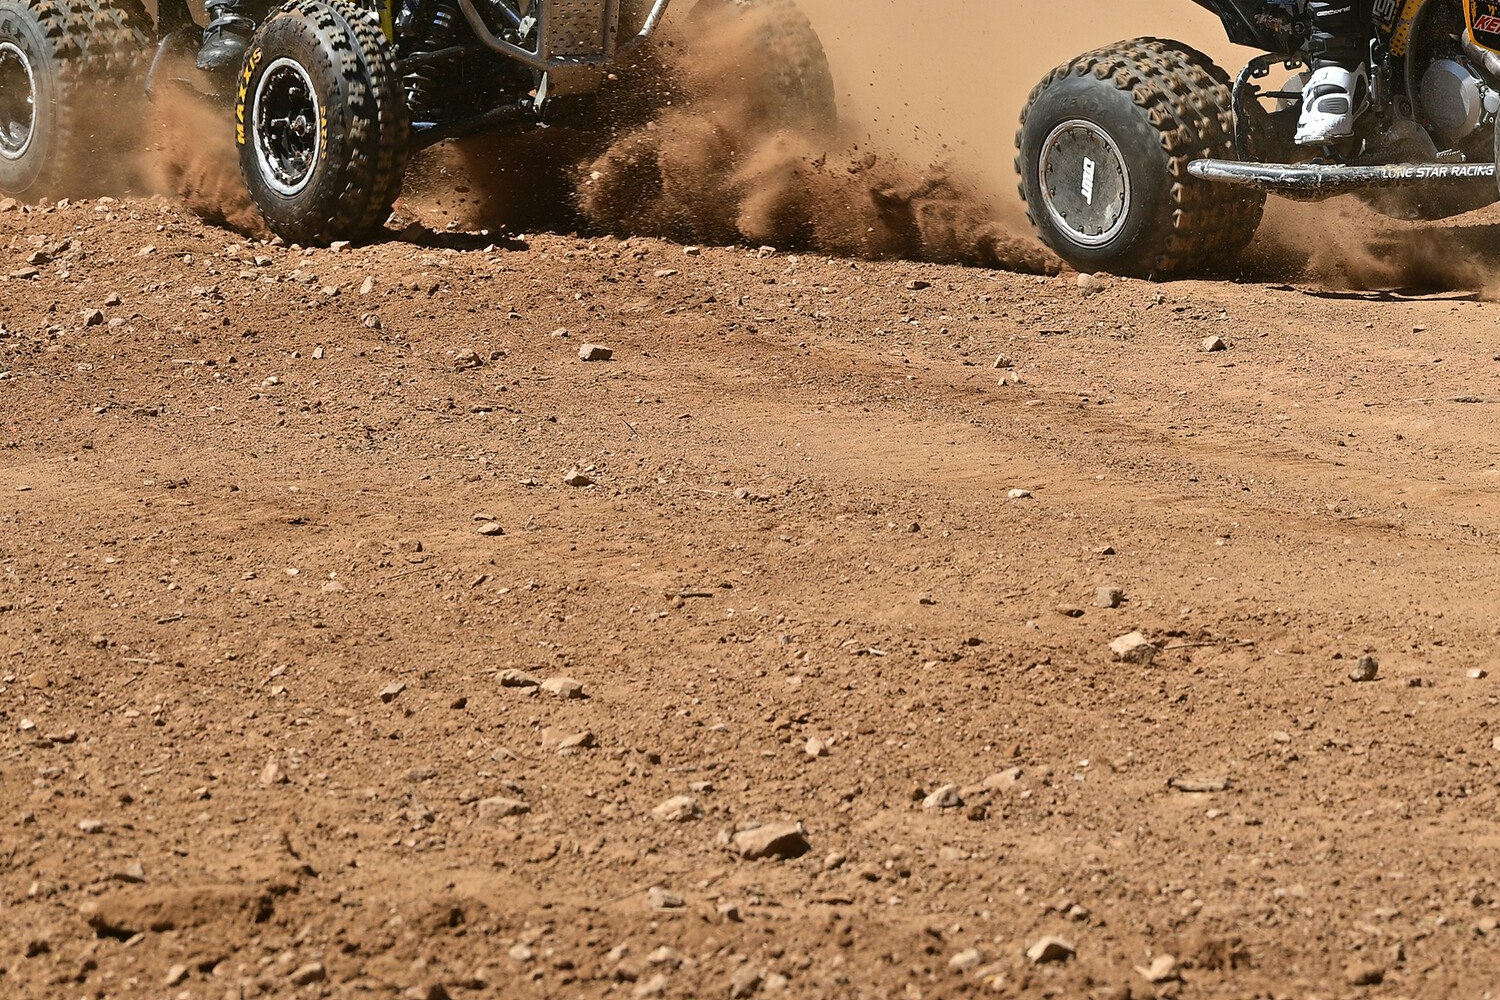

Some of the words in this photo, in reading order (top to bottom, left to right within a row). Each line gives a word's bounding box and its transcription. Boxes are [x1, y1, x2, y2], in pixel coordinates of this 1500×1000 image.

[236, 47, 262, 145] MAXXIS
[1382, 167, 1414, 179] LONE
[1415, 166, 1448, 178] STAR
[1451, 165, 1495, 177] RACING
